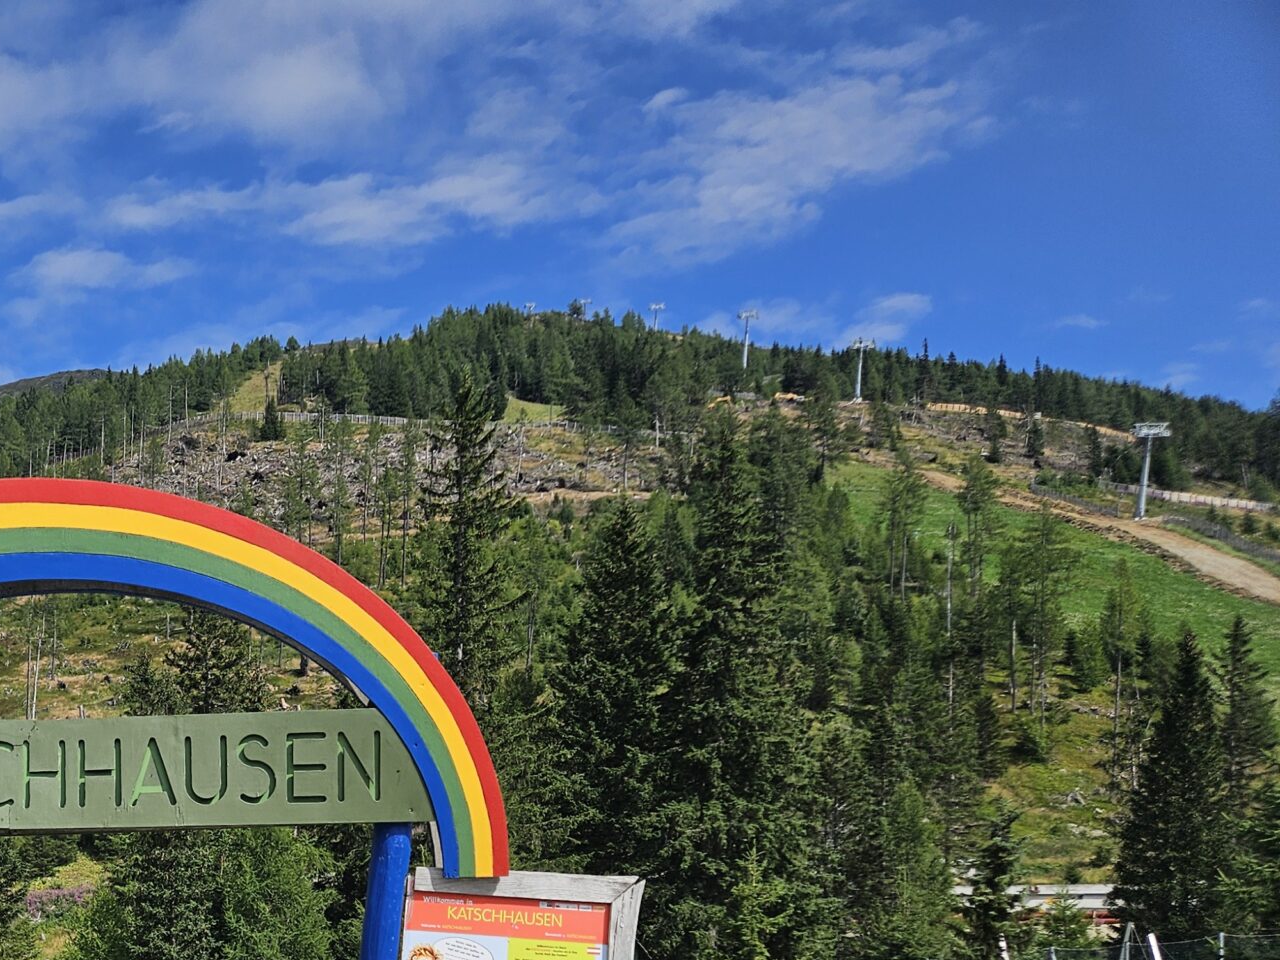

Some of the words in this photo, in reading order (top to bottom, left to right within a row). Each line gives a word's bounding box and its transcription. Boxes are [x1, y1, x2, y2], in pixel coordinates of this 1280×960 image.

[423, 896, 464, 906] Willkommen
[466, 898, 474, 906] in
[447, 905, 563, 928] KATSCHHAUSEN
